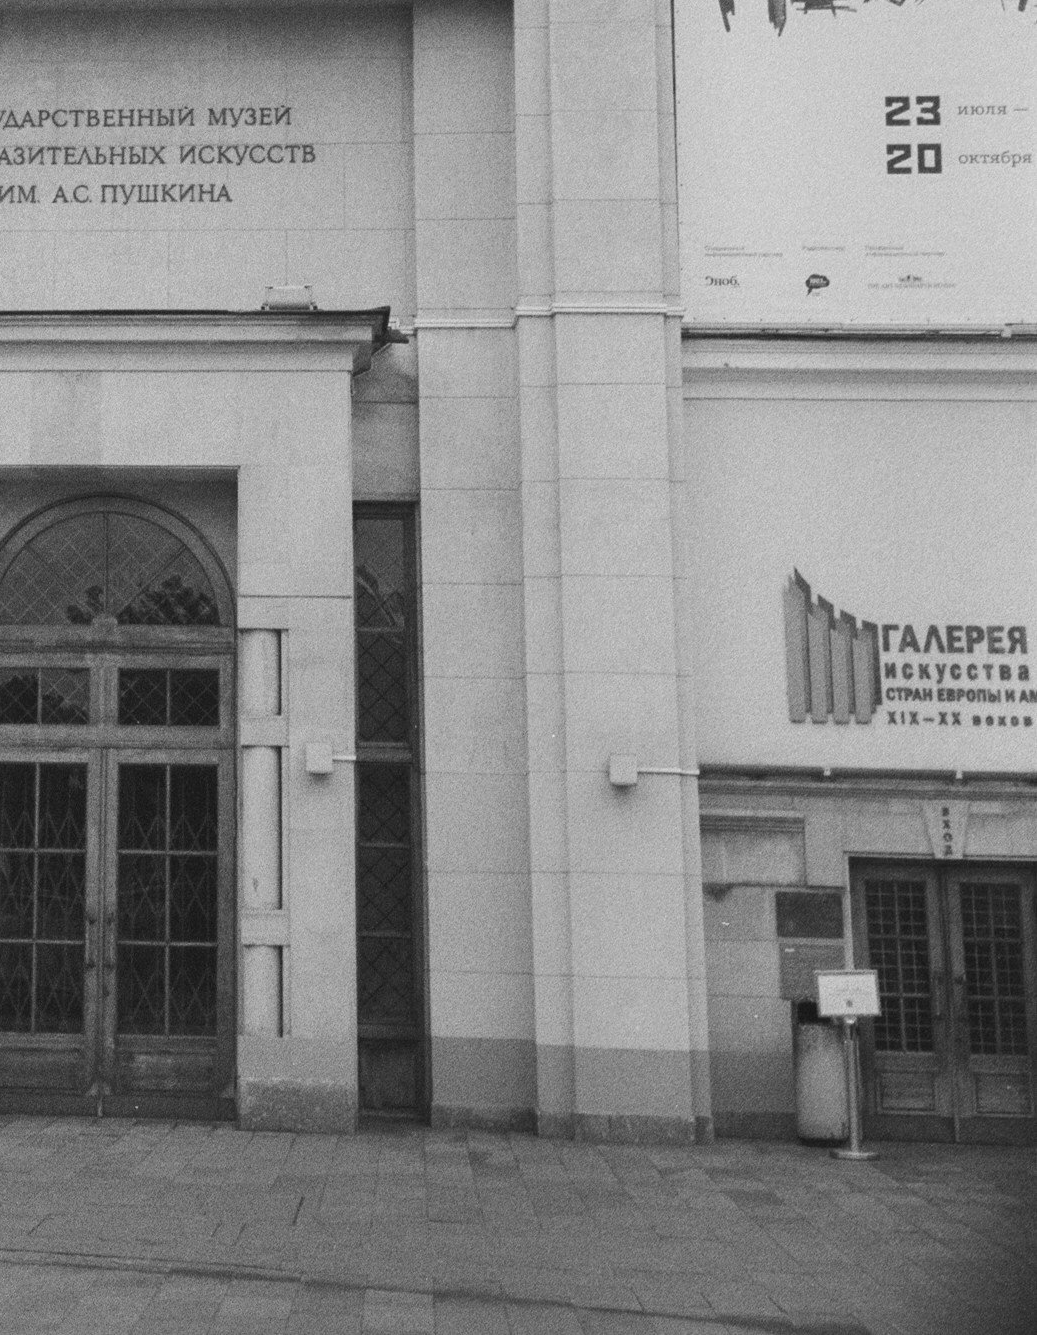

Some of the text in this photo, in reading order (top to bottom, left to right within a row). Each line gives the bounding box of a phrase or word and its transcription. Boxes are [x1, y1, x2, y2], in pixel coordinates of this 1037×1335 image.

[208, 105, 292, 127] МУЗЕЙ
[885, 96, 940, 126] 23
[958, 105, 1006, 115] июля
[180, 144, 316, 166] ИСКУССТВ
[887, 144, 1031, 174] 20 октября
[53, 184, 93, 203] А.С.
[101, 184, 232, 205] ПУШКИНА
[882, 624, 1027, 654] ГАЛЕРЕЯ
[884, 663, 1029, 684] искусства
[886, 687, 933, 701] СТРАН
[937, 688, 1001, 703] ЕВРОПЫ
[1005, 690, 1015, 702] И
